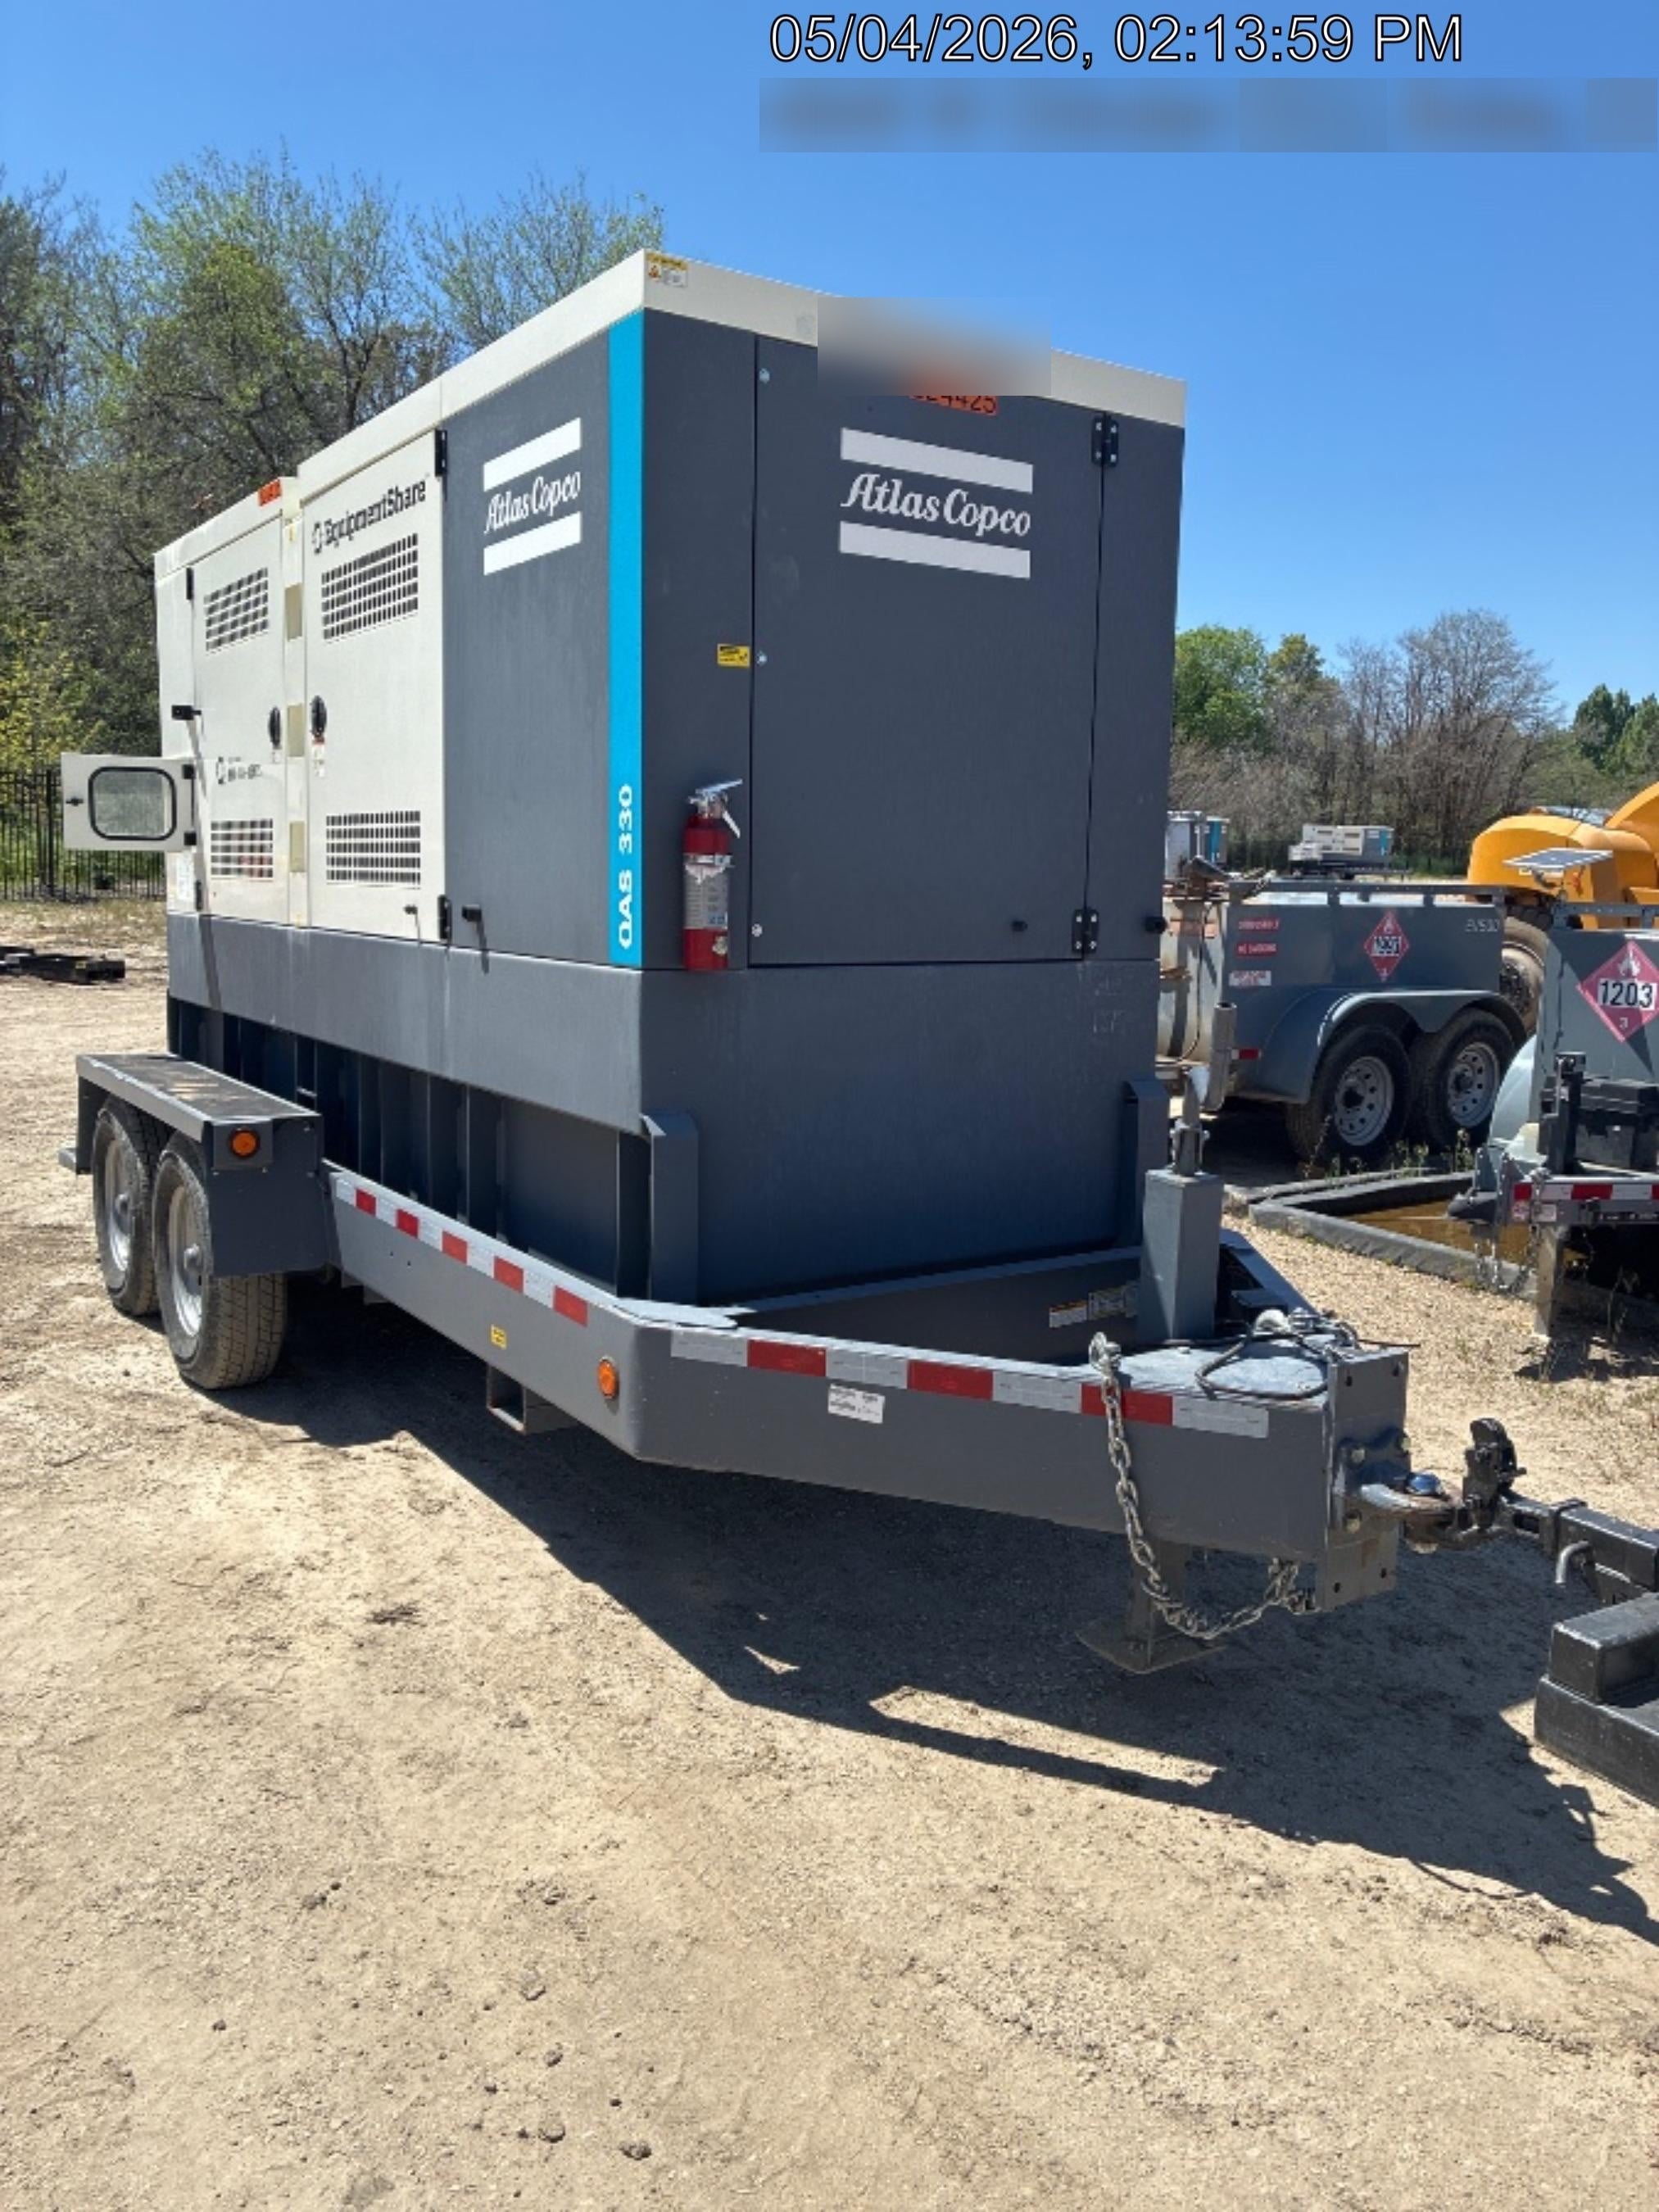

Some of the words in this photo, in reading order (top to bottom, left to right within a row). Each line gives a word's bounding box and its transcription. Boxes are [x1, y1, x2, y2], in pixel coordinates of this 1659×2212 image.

[324, 480, 426, 548] EquipmentShare
[483, 490, 529, 535] Atlas
[531, 470, 581, 517] Copco
[841, 473, 941, 523] Atlas
[943, 488, 1031, 537] Copco
[619, 784, 632, 854] 330
[619, 869, 632, 950] QAS
[1600, 980, 1653, 1009] 1203
[1619, 1017, 1629, 1029] 3
